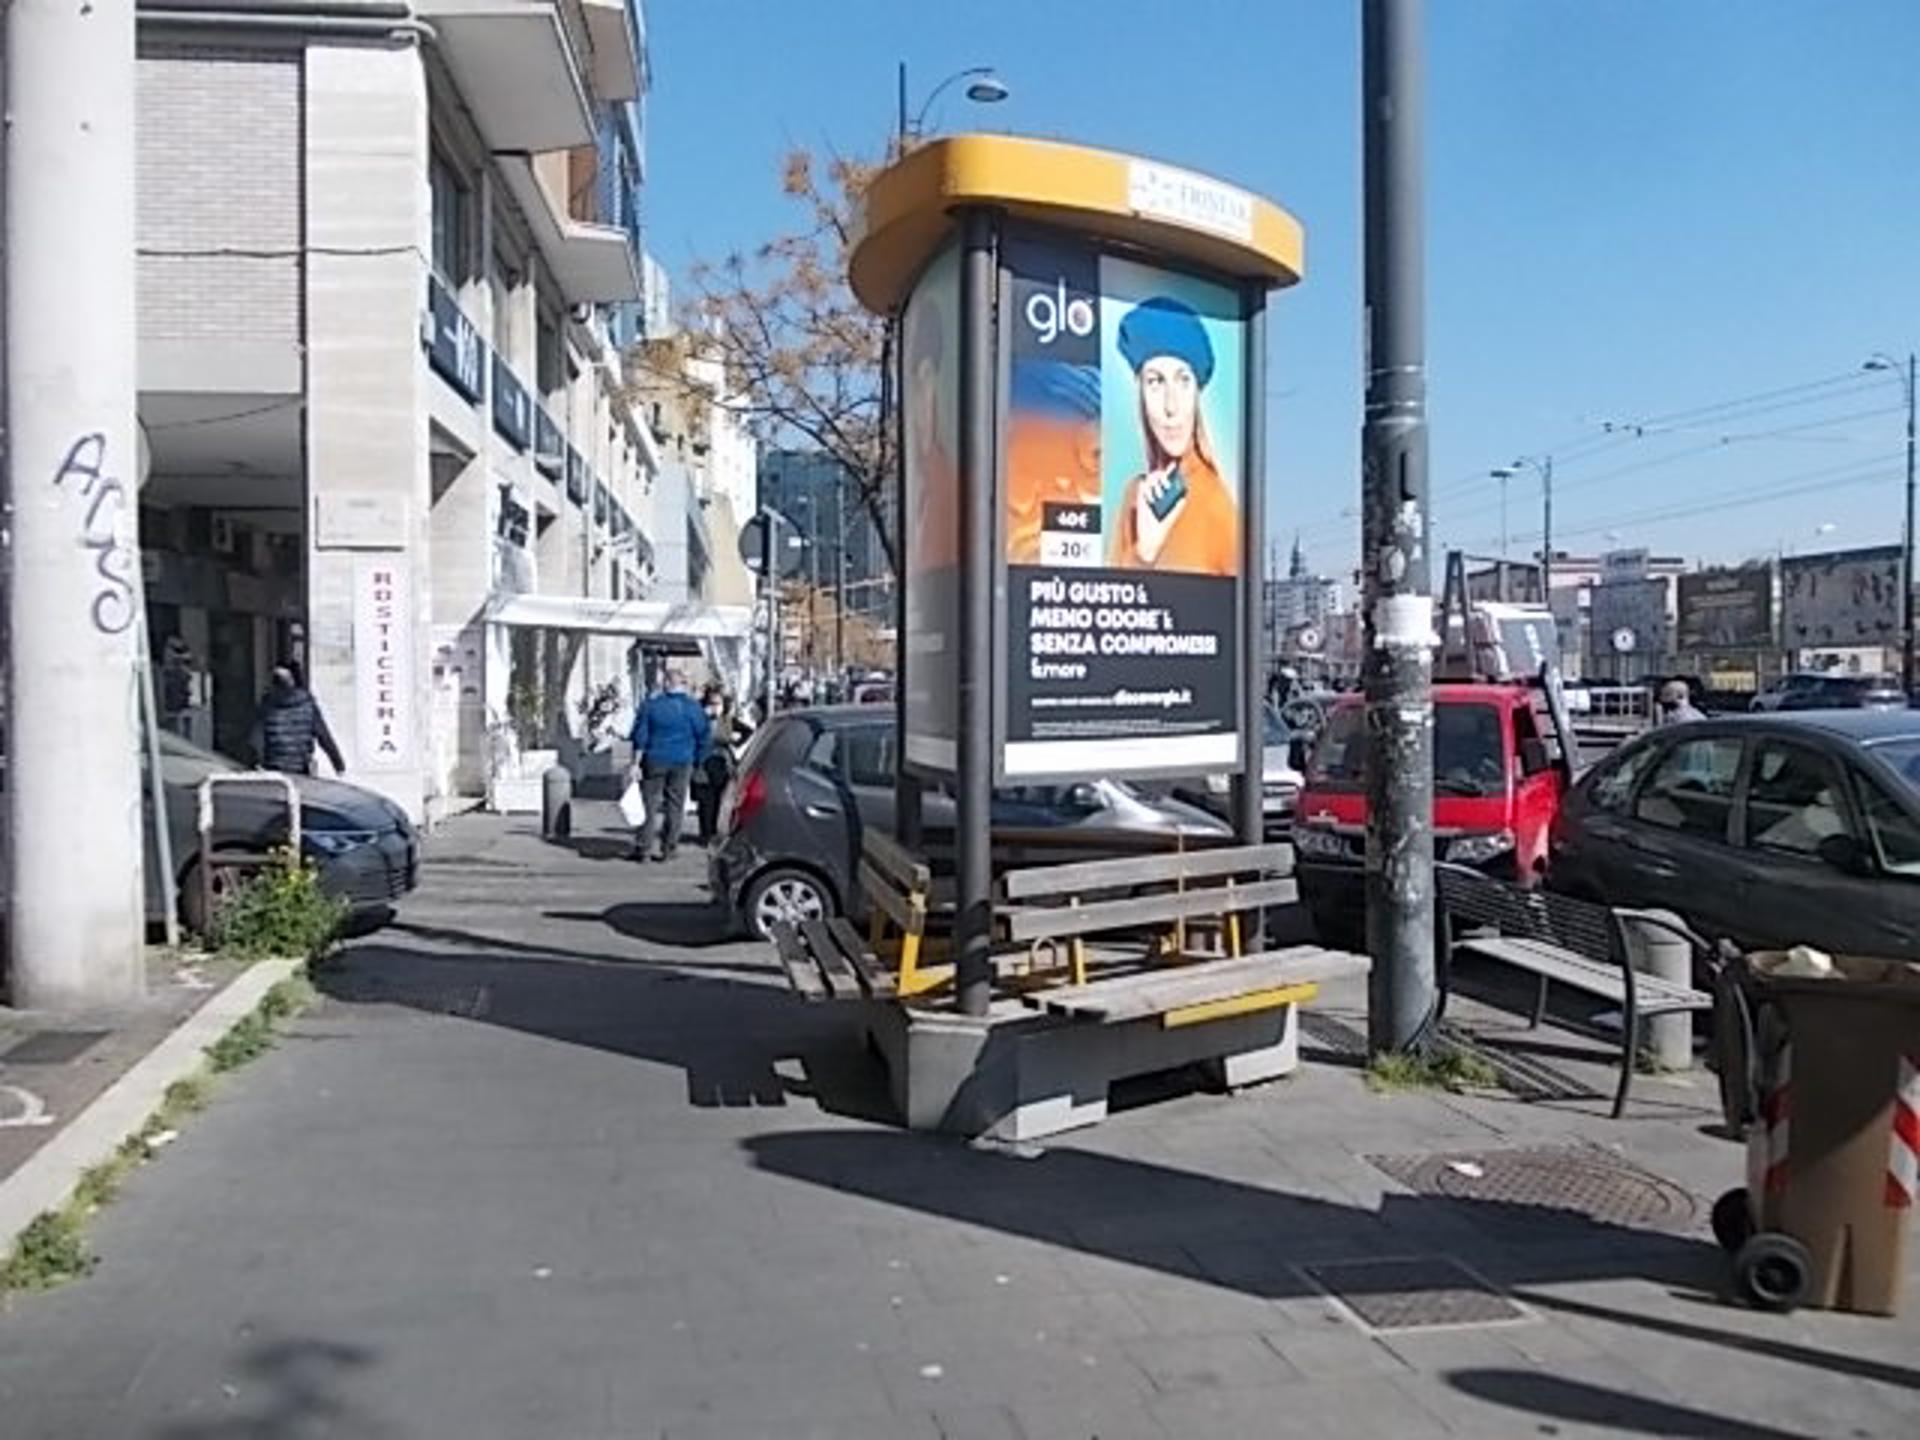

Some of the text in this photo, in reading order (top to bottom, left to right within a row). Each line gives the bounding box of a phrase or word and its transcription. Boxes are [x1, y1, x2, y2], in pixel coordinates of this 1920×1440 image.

[1030, 575, 1066, 602] PIÙ
[1069, 581, 1136, 604] GUSTO
[1030, 607, 1093, 629] MENO
[1096, 609, 1160, 630] ODORE
[1030, 632, 1098, 654] SENZA
[373, 571, 398, 755] ROSTICCERIA
